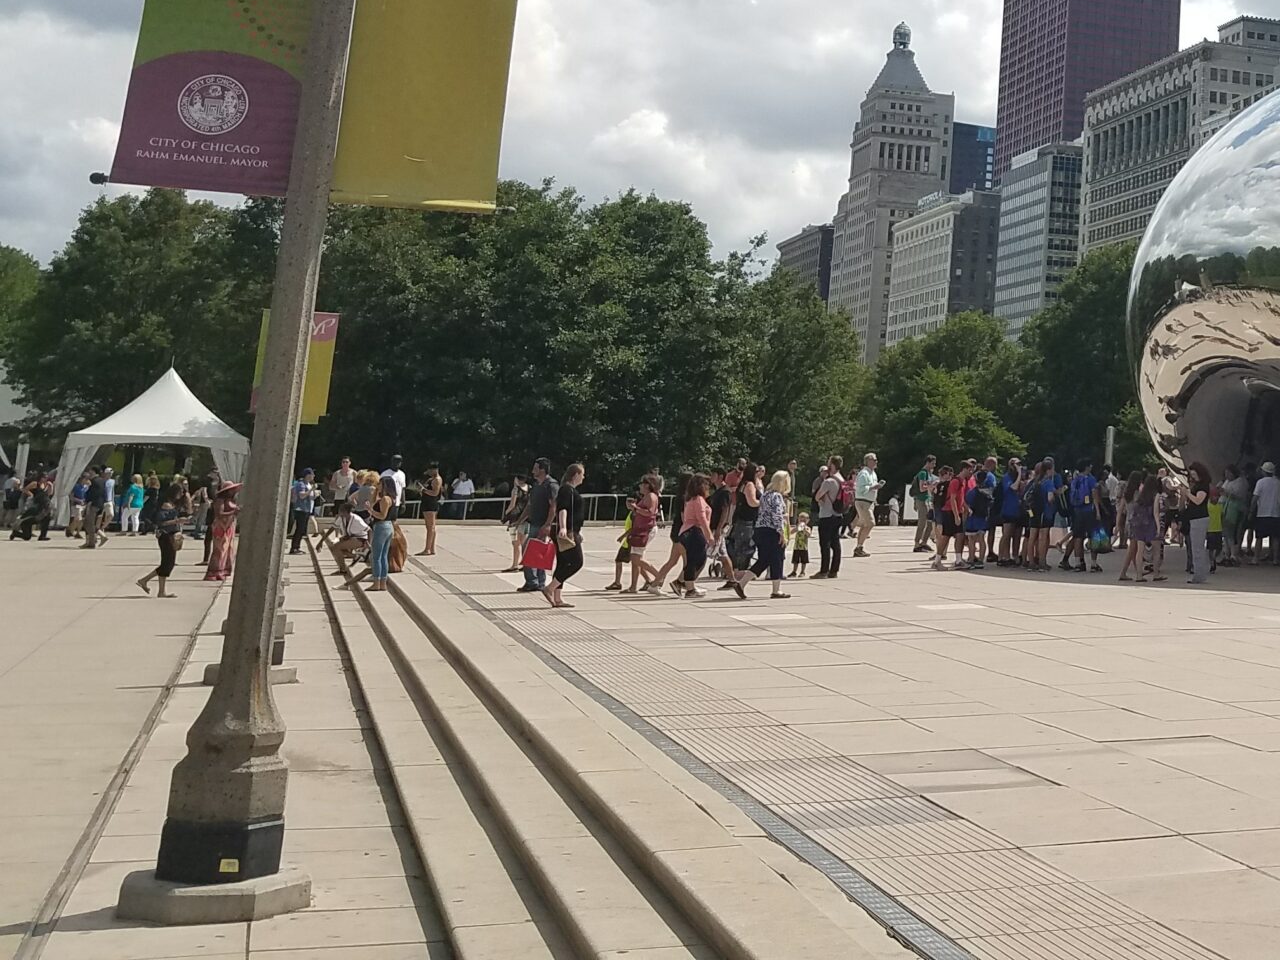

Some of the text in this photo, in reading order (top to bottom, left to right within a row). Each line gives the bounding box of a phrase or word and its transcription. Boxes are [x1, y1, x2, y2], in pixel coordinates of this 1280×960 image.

[191, 79, 205, 91] CITY
[216, 77, 242, 95] CHICAGO
[149, 137, 260, 154] CITY OF CHICAGO
[136, 149, 169, 160] RAHM
[230, 158, 269, 168] MAYOR
